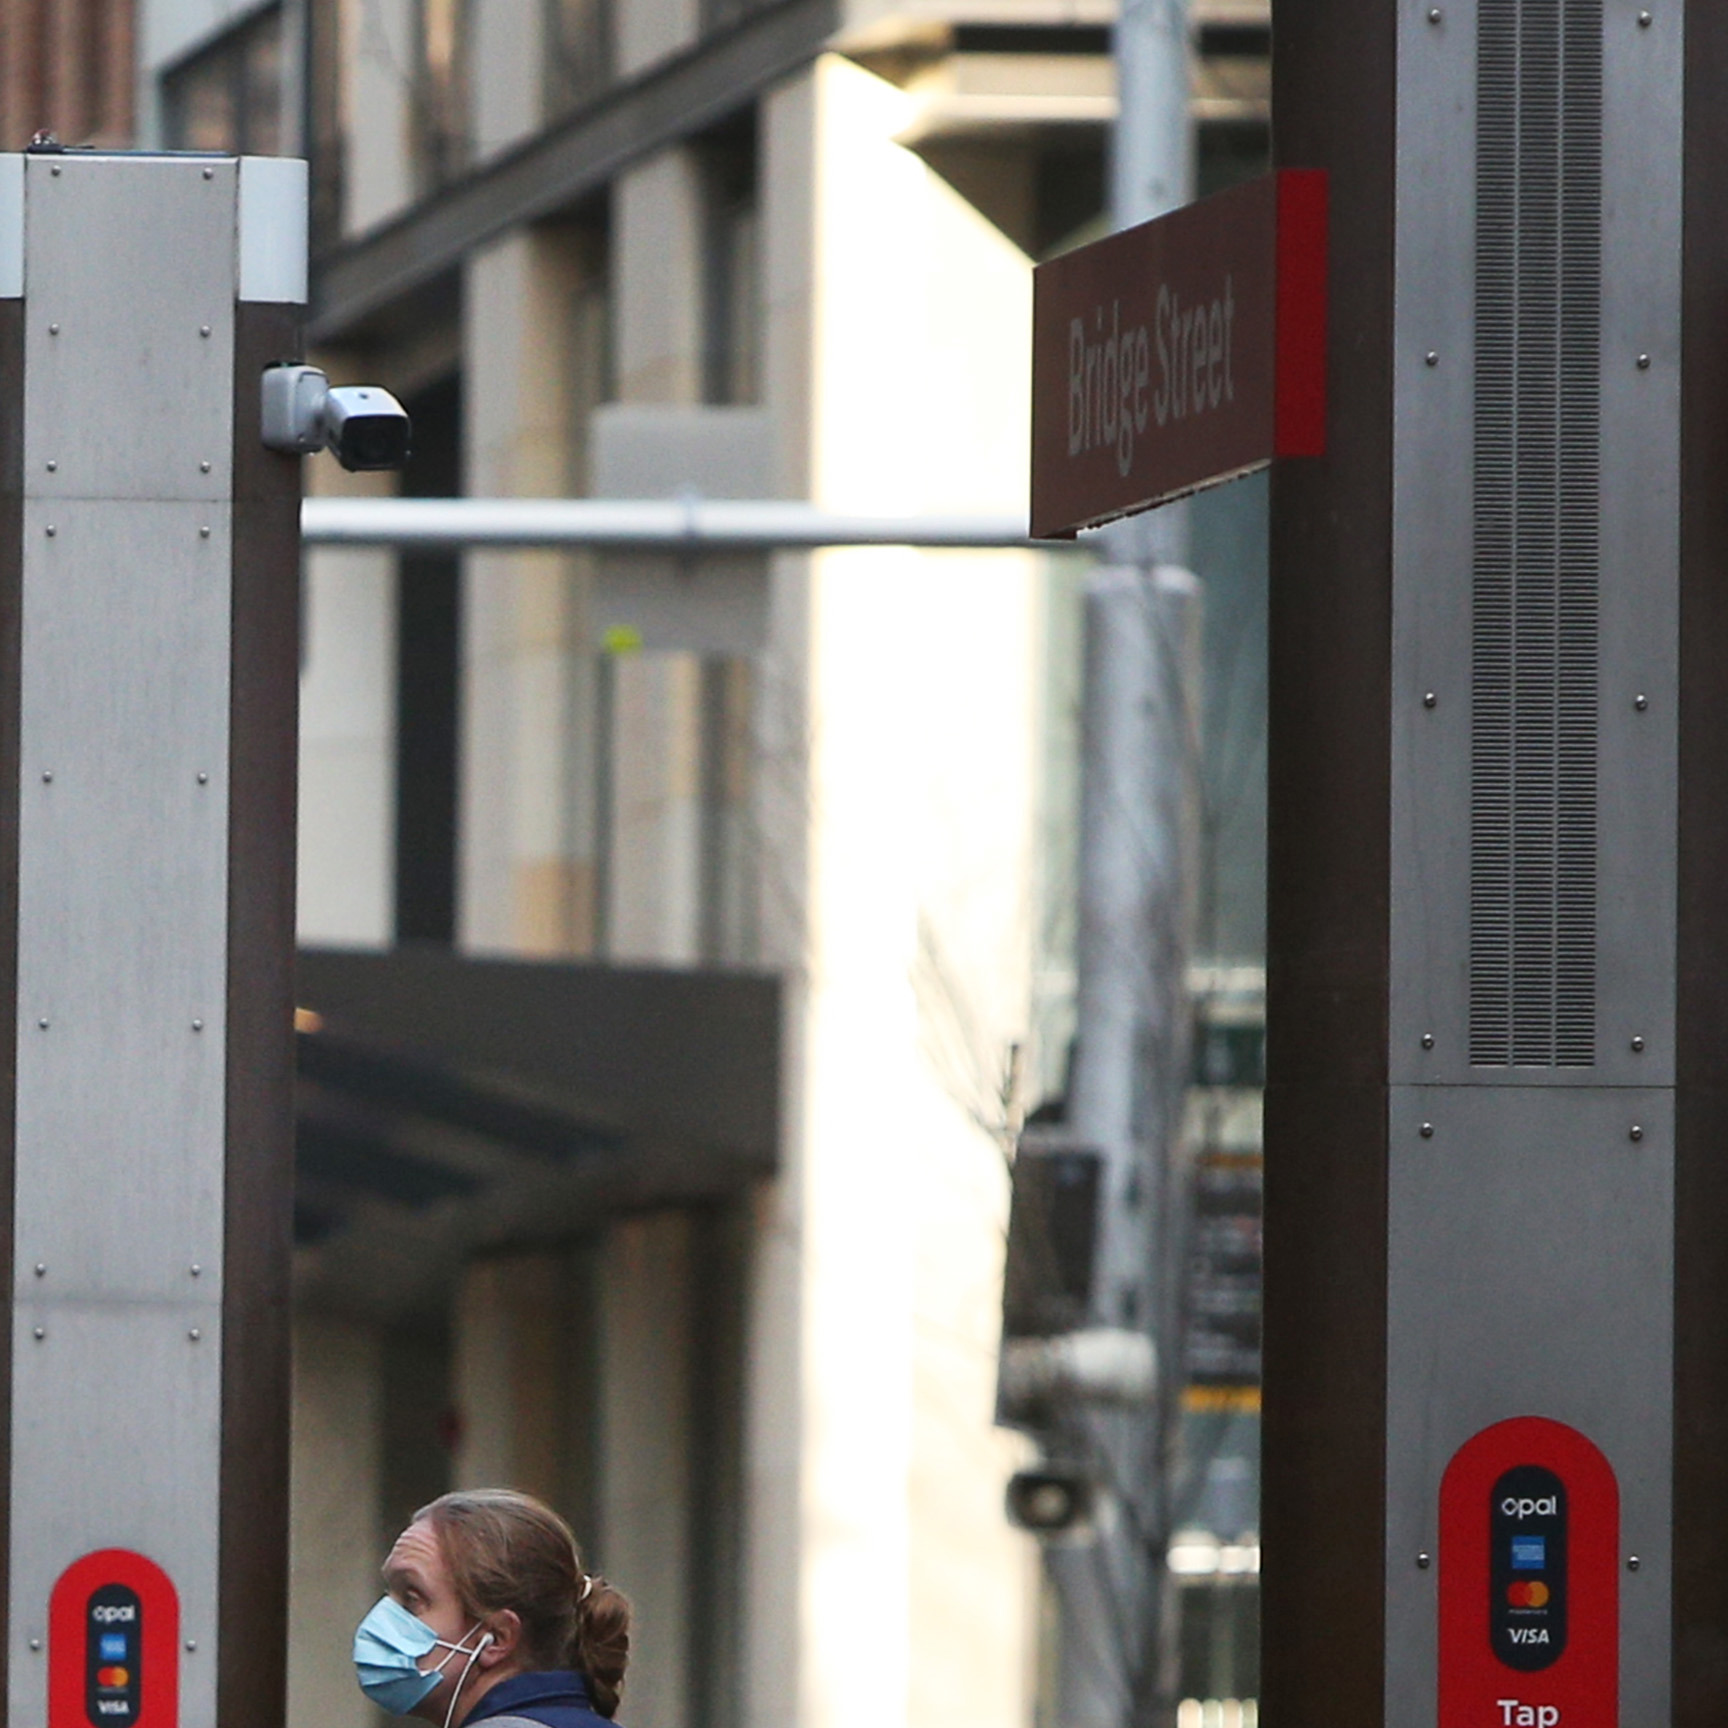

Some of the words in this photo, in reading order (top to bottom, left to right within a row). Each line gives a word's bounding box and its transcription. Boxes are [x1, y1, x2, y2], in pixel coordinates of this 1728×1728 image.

[1068, 299, 1149, 477] Bridge
[1154, 273, 1236, 427] Street
[1501, 1495, 1556, 1520] opal
[93, 1604, 135, 1624] opal
[1506, 1627, 1550, 1645] VISA
[97, 1699, 130, 1715] VISA
